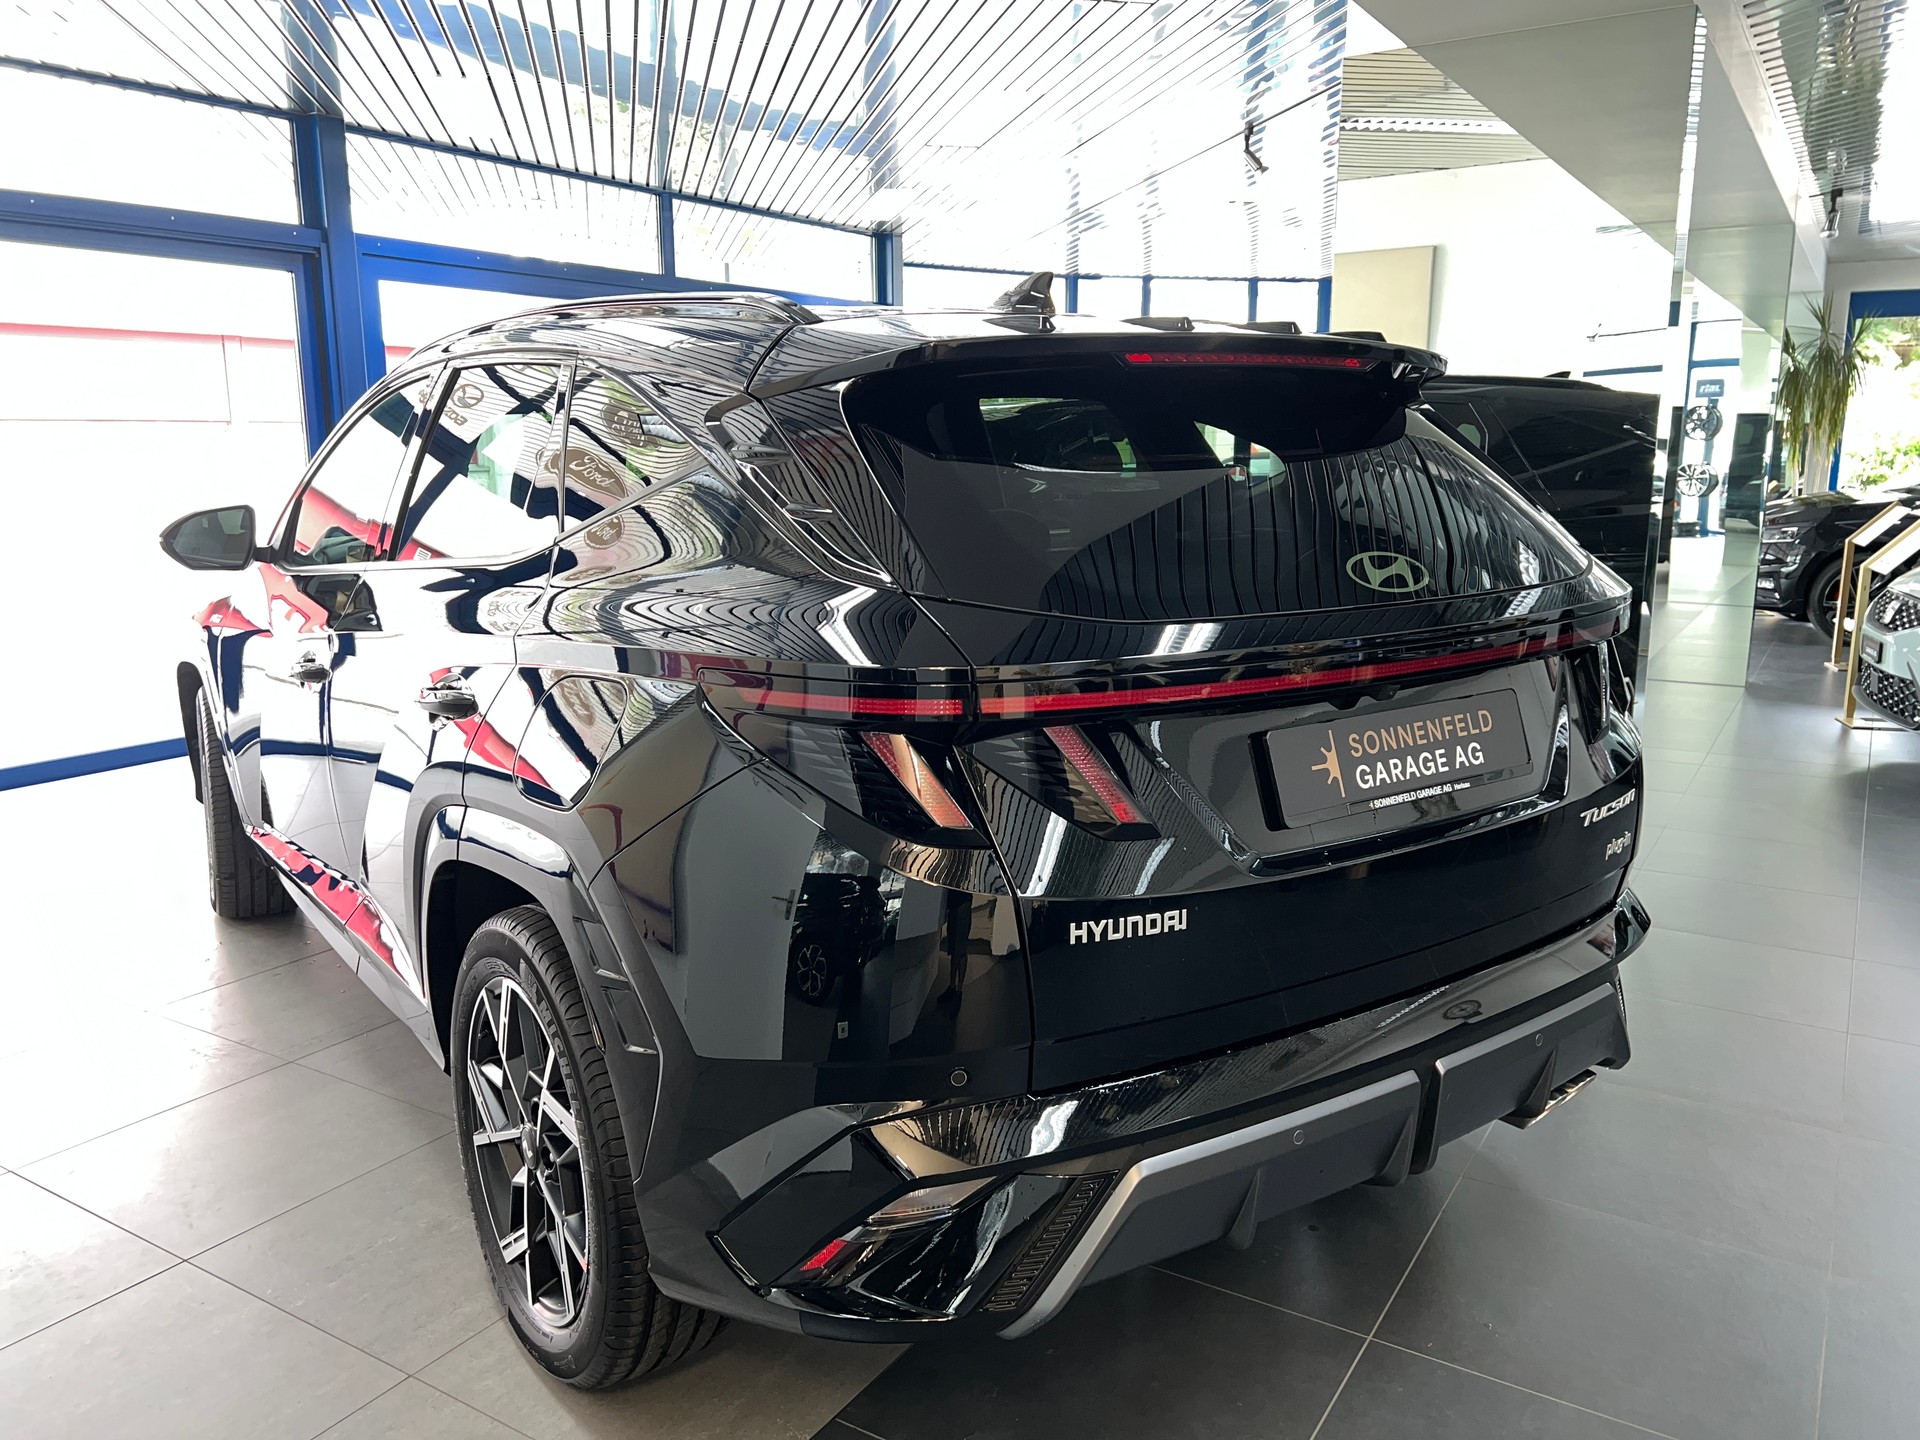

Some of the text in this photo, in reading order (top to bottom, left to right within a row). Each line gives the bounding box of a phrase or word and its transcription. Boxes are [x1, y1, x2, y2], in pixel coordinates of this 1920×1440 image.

[569, 455, 616, 487] Ford
[1348, 709, 1493, 758] SONNENFELD
[1356, 742, 1485, 789] GARAGE AG
[1374, 791, 1416, 809] SONNENFELD
[1417, 785, 1443, 798] GARAGE
[1443, 783, 1453, 793] AG
[1070, 909, 1188, 945] HYUNDAI
